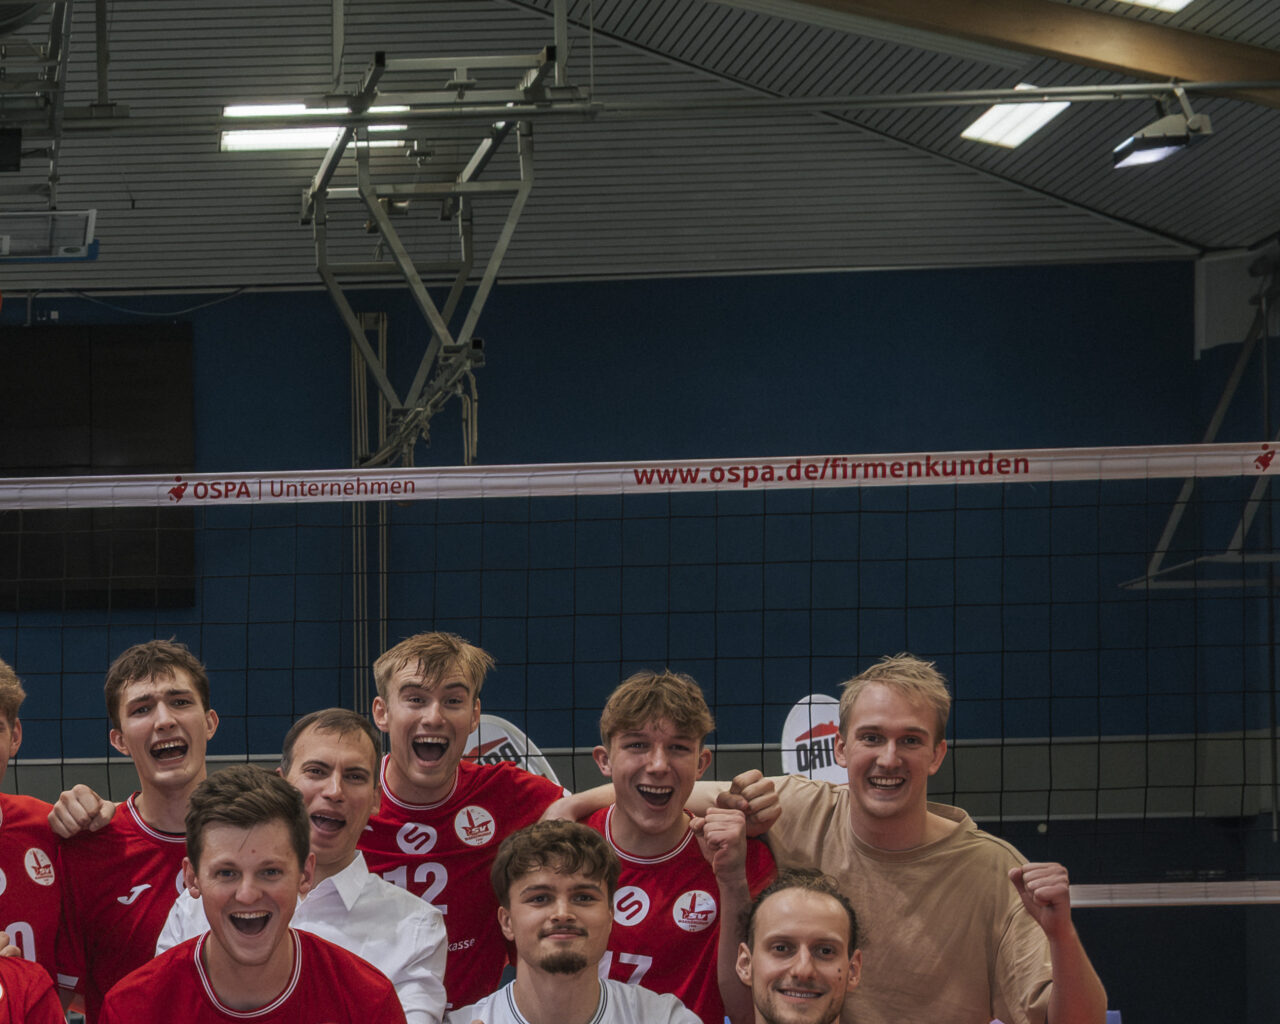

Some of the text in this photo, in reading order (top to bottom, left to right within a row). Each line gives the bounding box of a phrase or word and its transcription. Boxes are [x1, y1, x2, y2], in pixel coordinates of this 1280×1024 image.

[633, 452, 1030, 488] www.ospa.de/firmenkunden
[193, 477, 416, 499] OSPA Unternehmen
